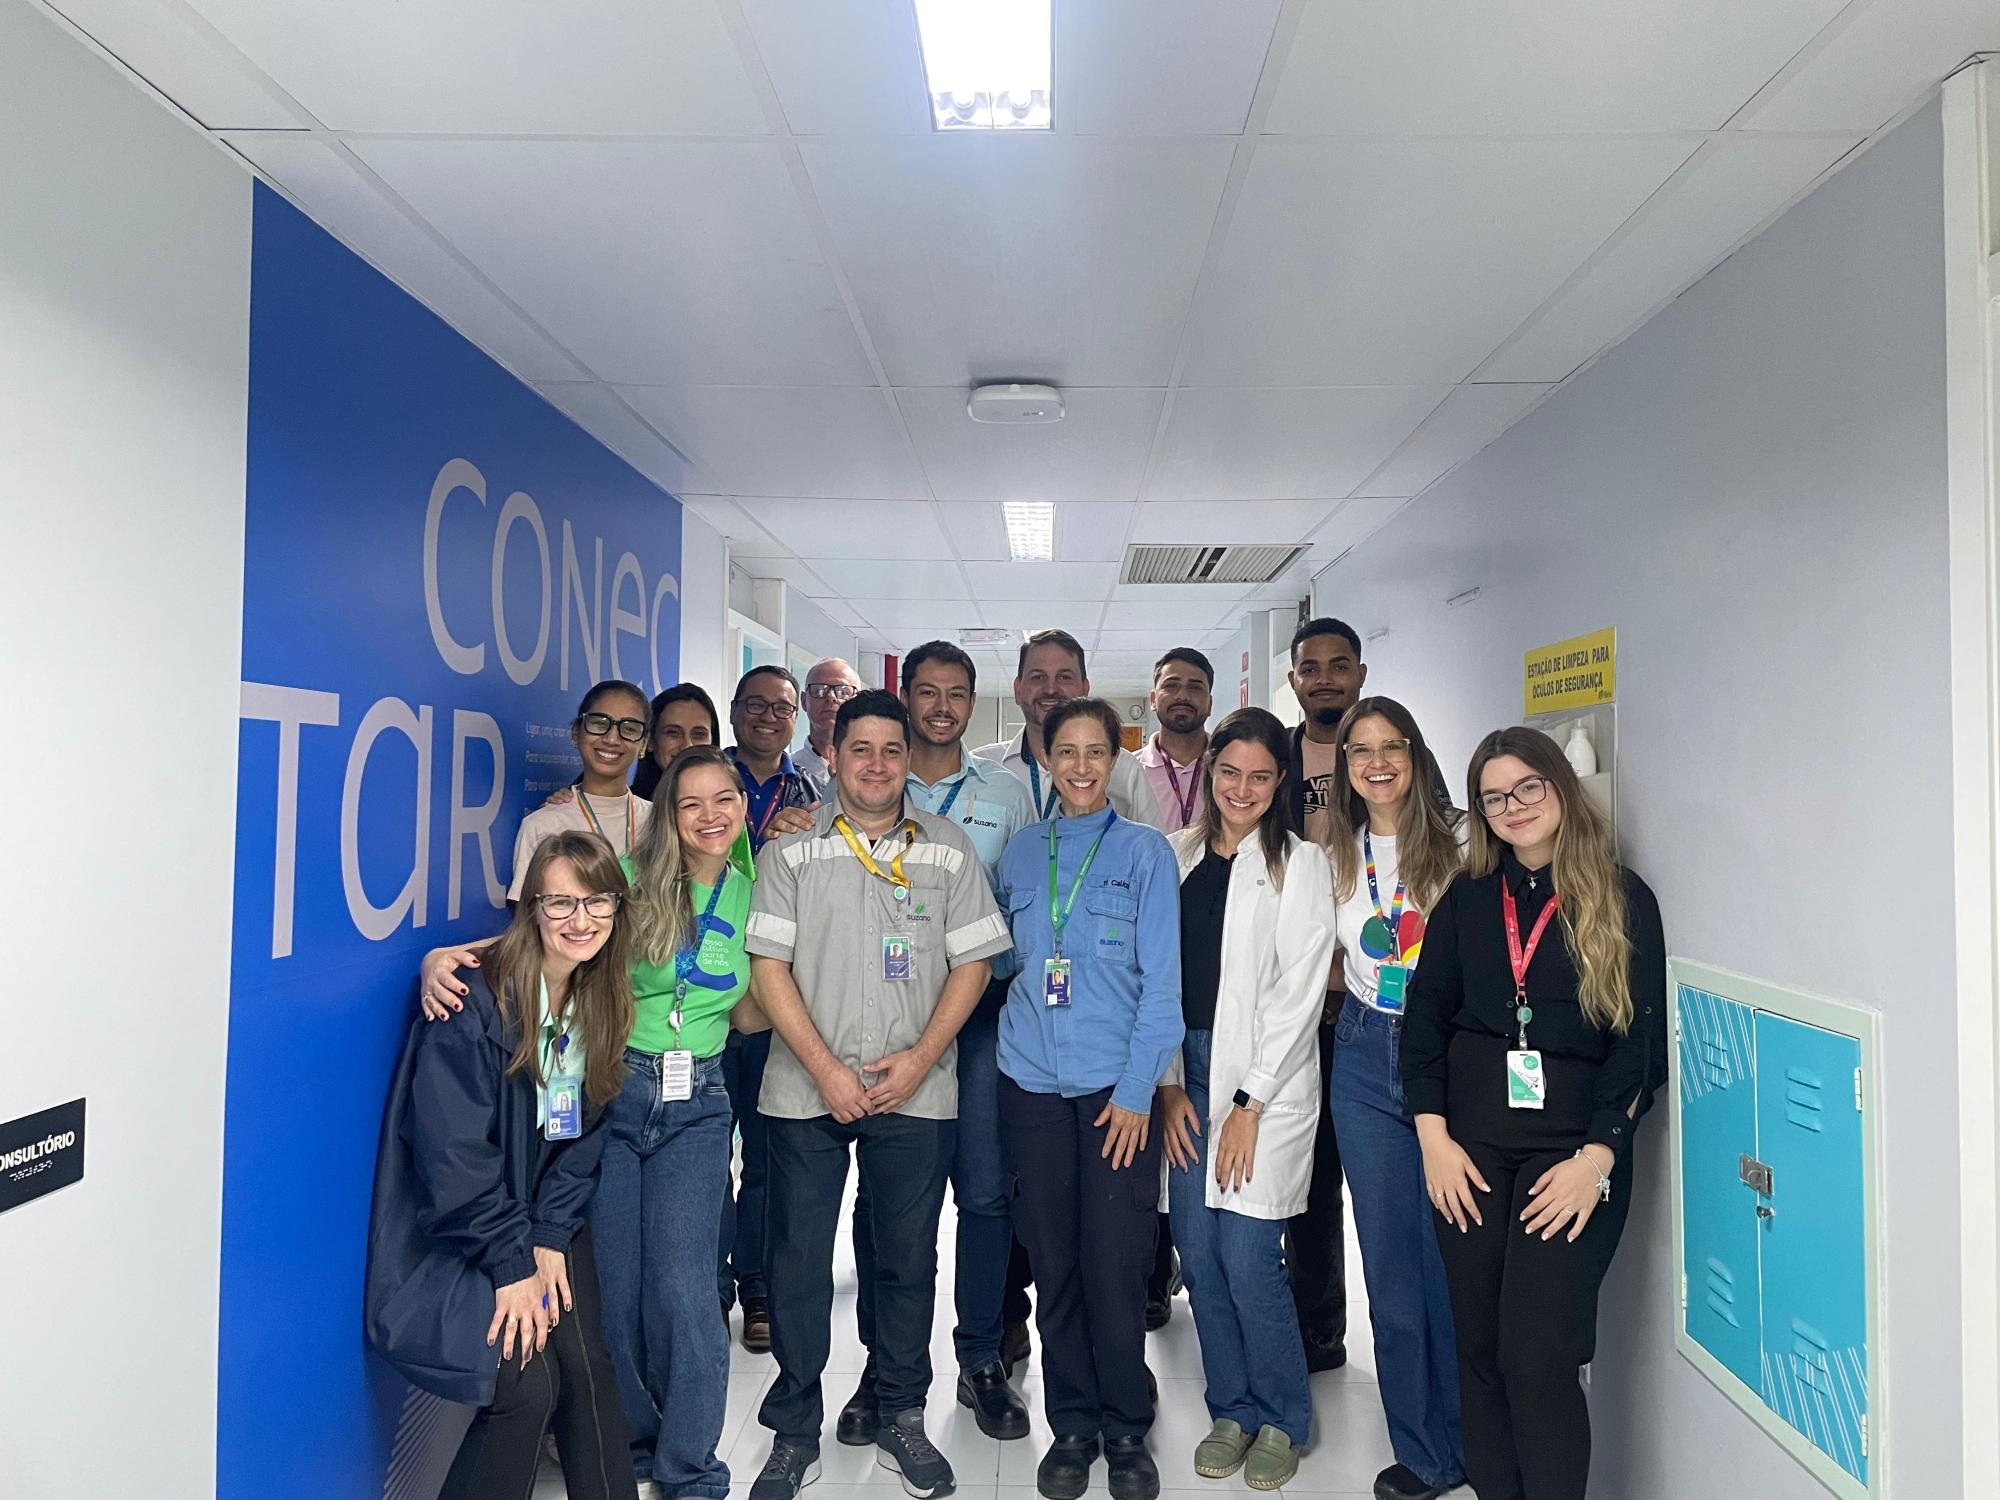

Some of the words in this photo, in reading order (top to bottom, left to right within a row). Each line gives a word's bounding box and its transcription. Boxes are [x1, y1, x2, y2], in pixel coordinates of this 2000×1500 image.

[1528, 656, 1552, 678] ESTAÇÃO
[1553, 656, 1561, 672] DE
[1562, 650, 1589, 670] LIMPEZA
[1592, 645, 1610, 664] PARA
[1532, 680, 1554, 699] ÓCULOS
[1555, 678, 1563, 694] DE
[1564, 672, 1603, 693] SEGURANÇA
[974, 819, 997, 828] suzano
[0, 1130, 75, 1172] ONSULTÓRIO
